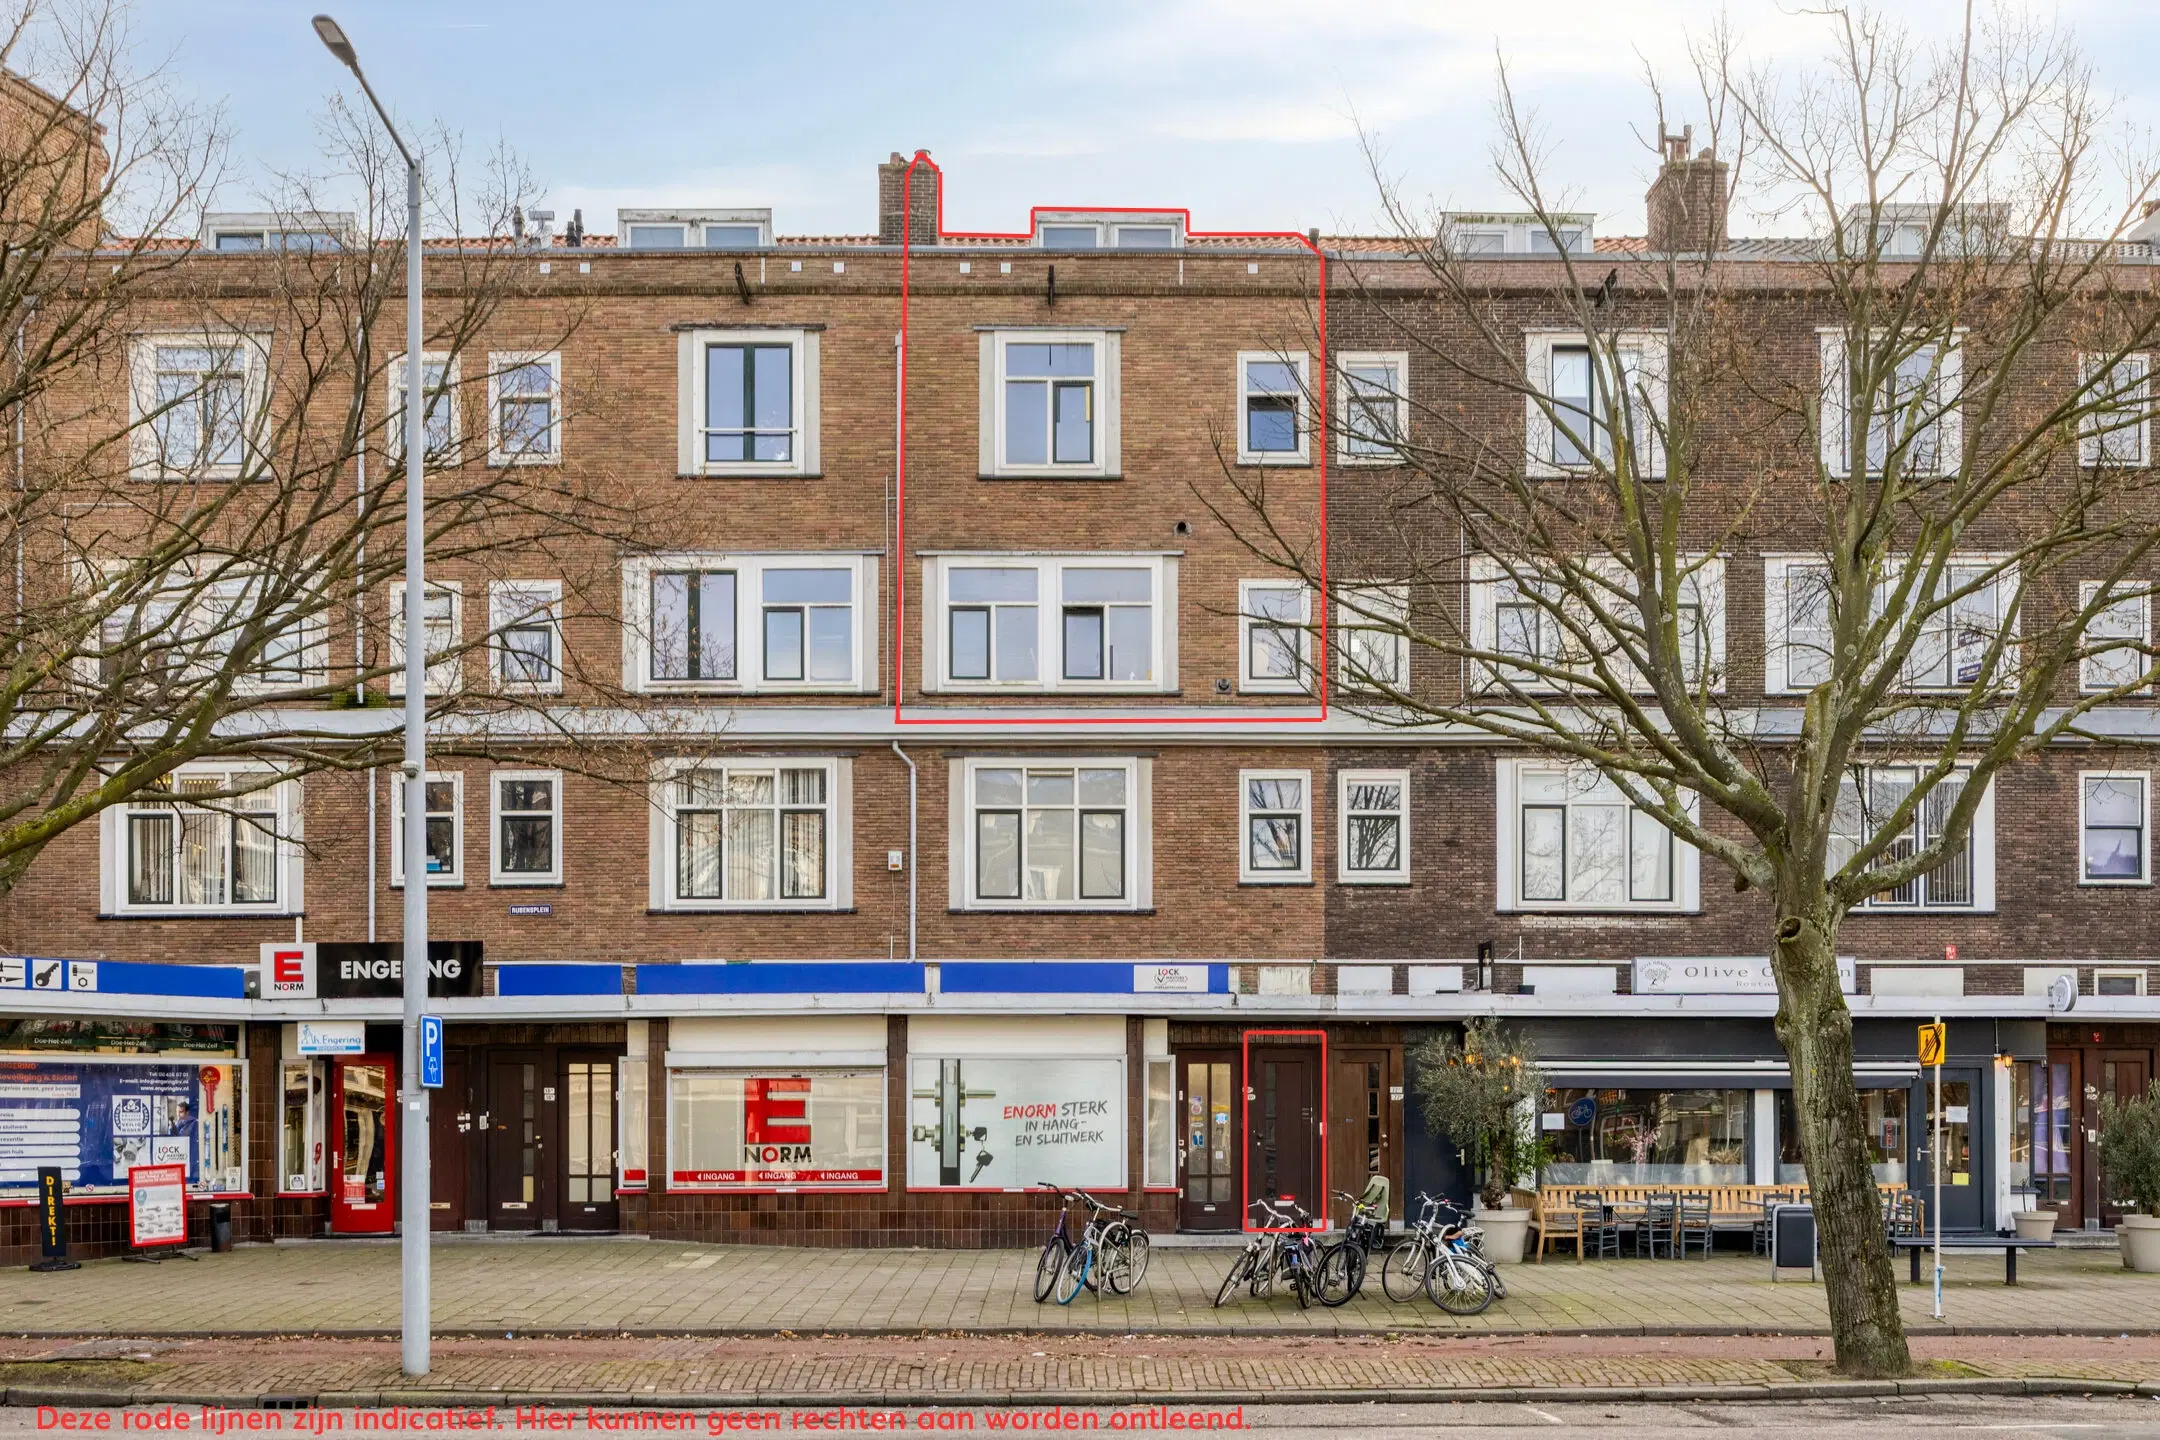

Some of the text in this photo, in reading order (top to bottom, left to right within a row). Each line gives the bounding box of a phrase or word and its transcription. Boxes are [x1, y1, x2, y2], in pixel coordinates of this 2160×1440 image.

[341, 959, 462, 980] ENGENG
[1684, 966, 1749, 978] Olive
[274, 983, 304, 991] NORM
[426, 1021, 438, 1057] P
[1003, 1100, 1108, 1119] ENORM STERK
[1025, 1118, 1087, 1132] IN HANG-
[1015, 1130, 1104, 1147] EN SLUITWERK
[158, 1145, 180, 1154] LOCK
[744, 1146, 812, 1163] NORM
[703, 1173, 735, 1181] INGANG
[764, 1172, 796, 1180] INGANG
[826, 1171, 858, 1180] INGANG
[45, 1175, 57, 1246] DIREKT!
